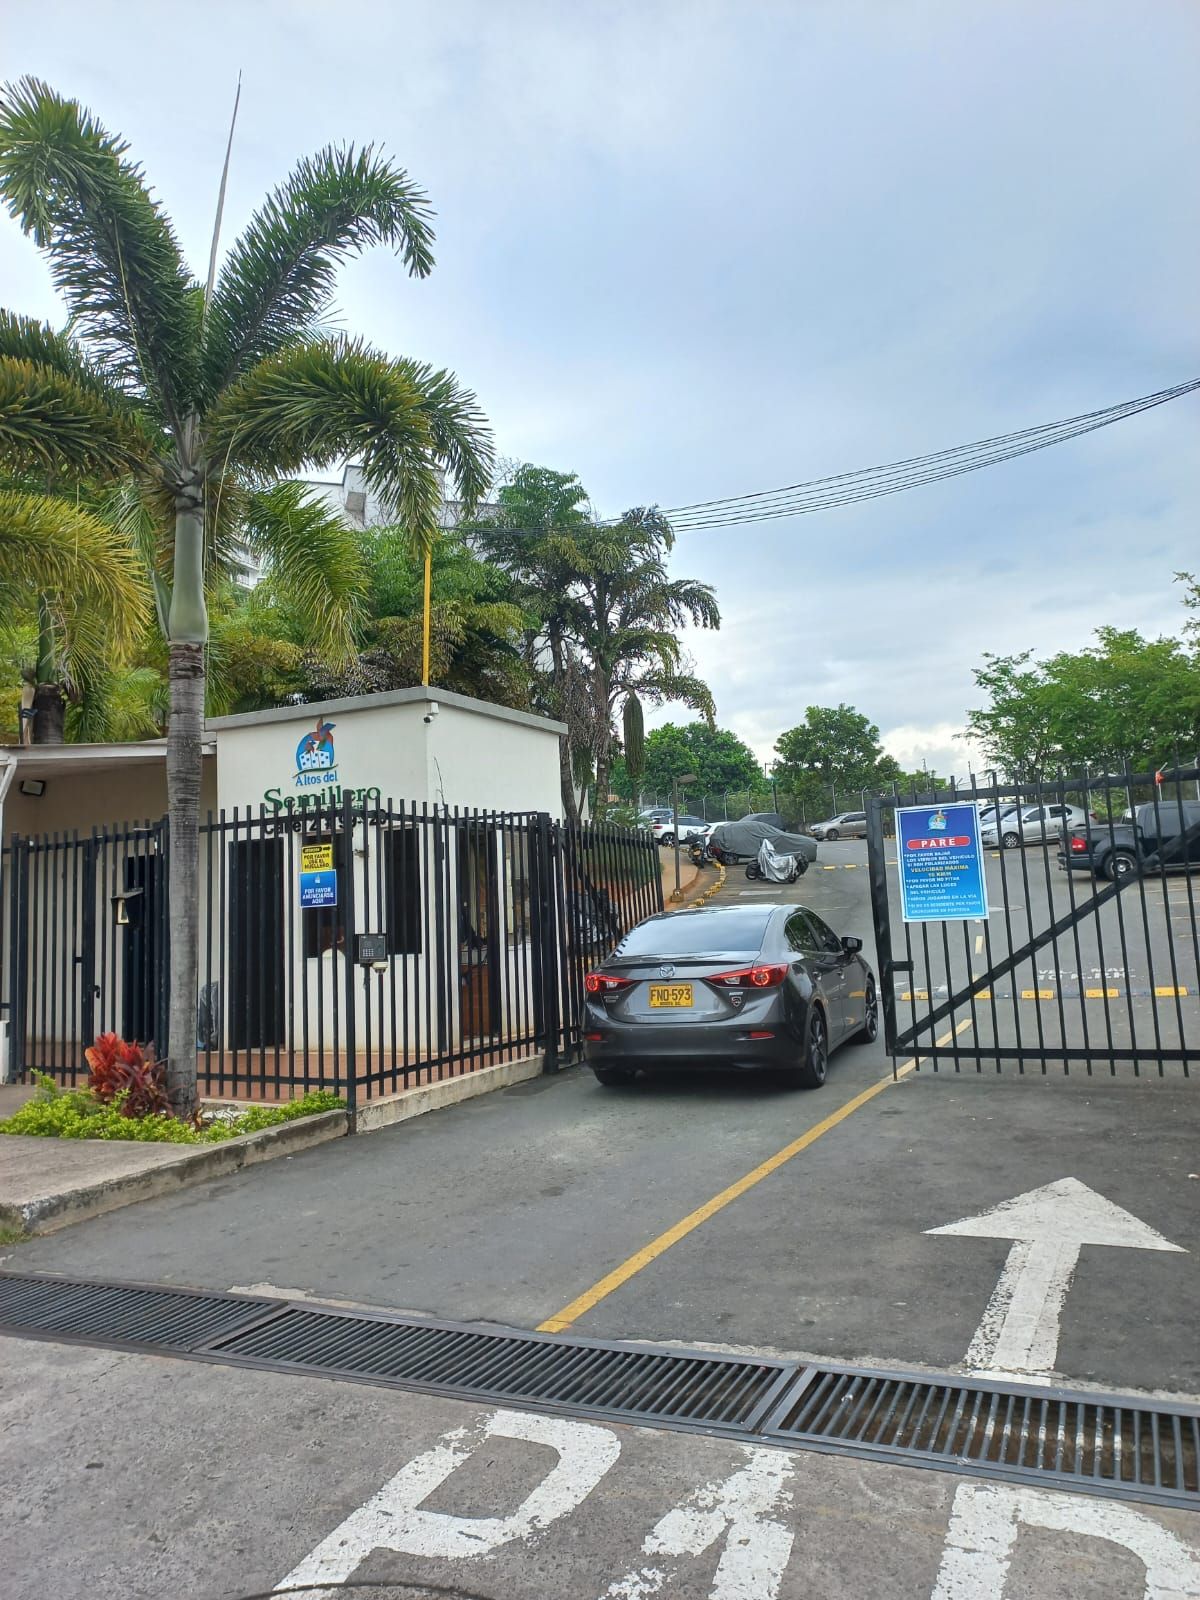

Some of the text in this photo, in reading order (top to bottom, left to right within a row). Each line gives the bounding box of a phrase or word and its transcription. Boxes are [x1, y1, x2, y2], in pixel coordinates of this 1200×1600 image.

[295, 770, 338, 787] Altos del
[920, 838, 956, 848] PARE
